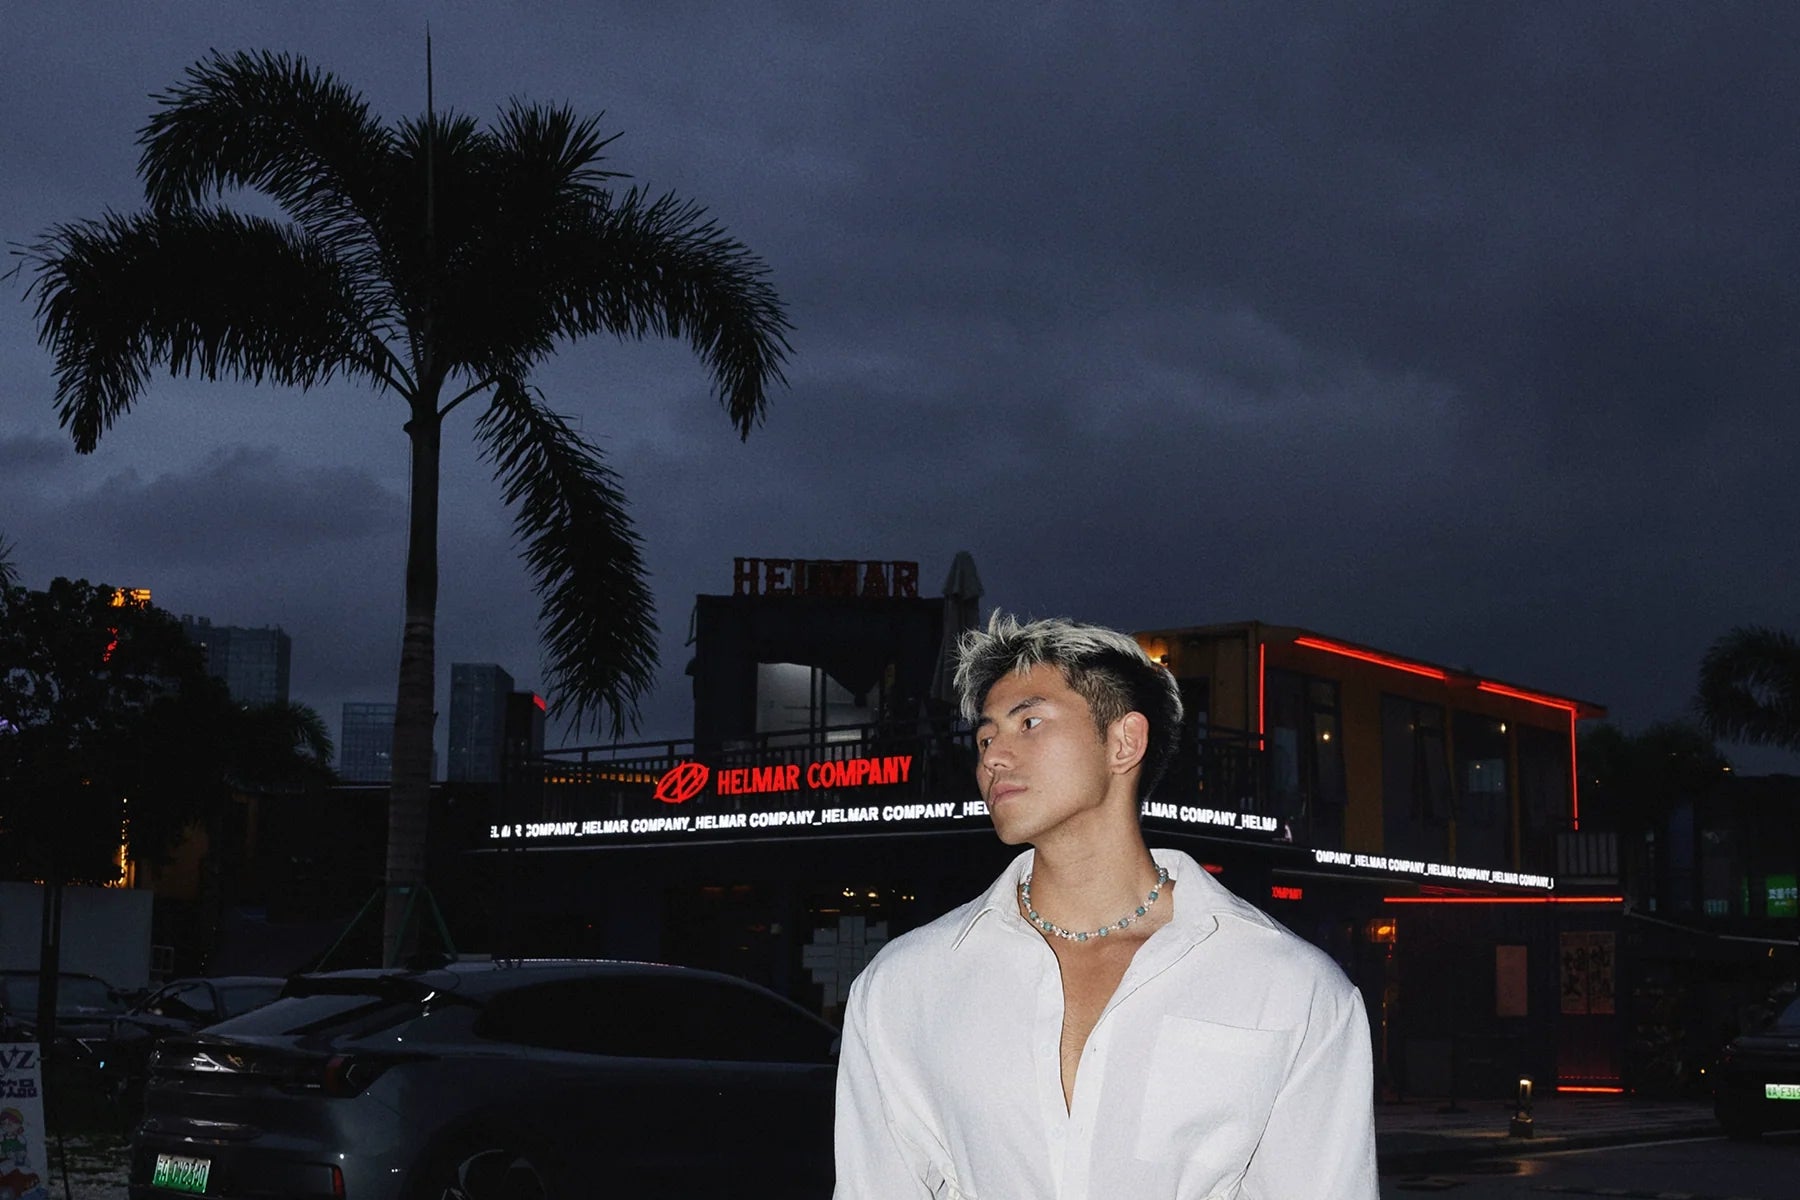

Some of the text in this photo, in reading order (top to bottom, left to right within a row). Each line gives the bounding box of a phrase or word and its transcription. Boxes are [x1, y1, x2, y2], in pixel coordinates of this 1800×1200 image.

[733, 557, 919, 600] HELMAR
[718, 756, 911, 794] HELMAR COMPANY
[631, 814, 746, 833] COMPANY_HELMAR
[749, 807, 878, 827] COMPANY_HELMAR
[1312, 849, 1387, 869] OMPANY_HELMAR
